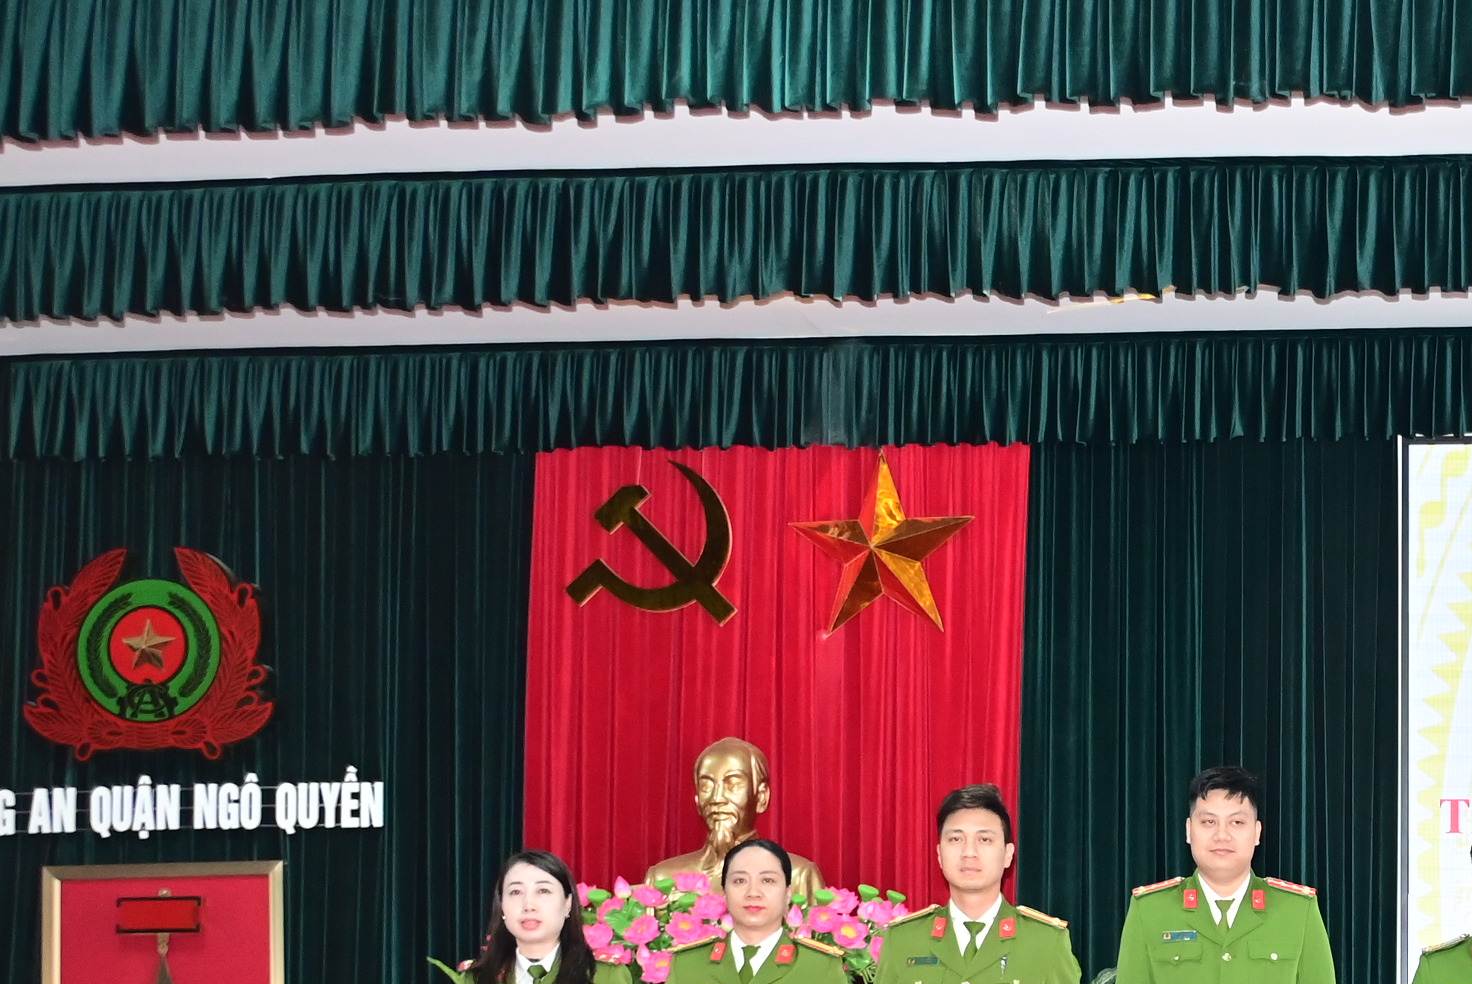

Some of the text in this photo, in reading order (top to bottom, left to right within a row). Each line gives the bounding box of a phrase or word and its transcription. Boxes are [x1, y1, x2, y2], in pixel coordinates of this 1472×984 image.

[28, 787, 77, 834] AN
[89, 774, 181, 839] QUẬN
[193, 772, 262, 830] NGÔ
